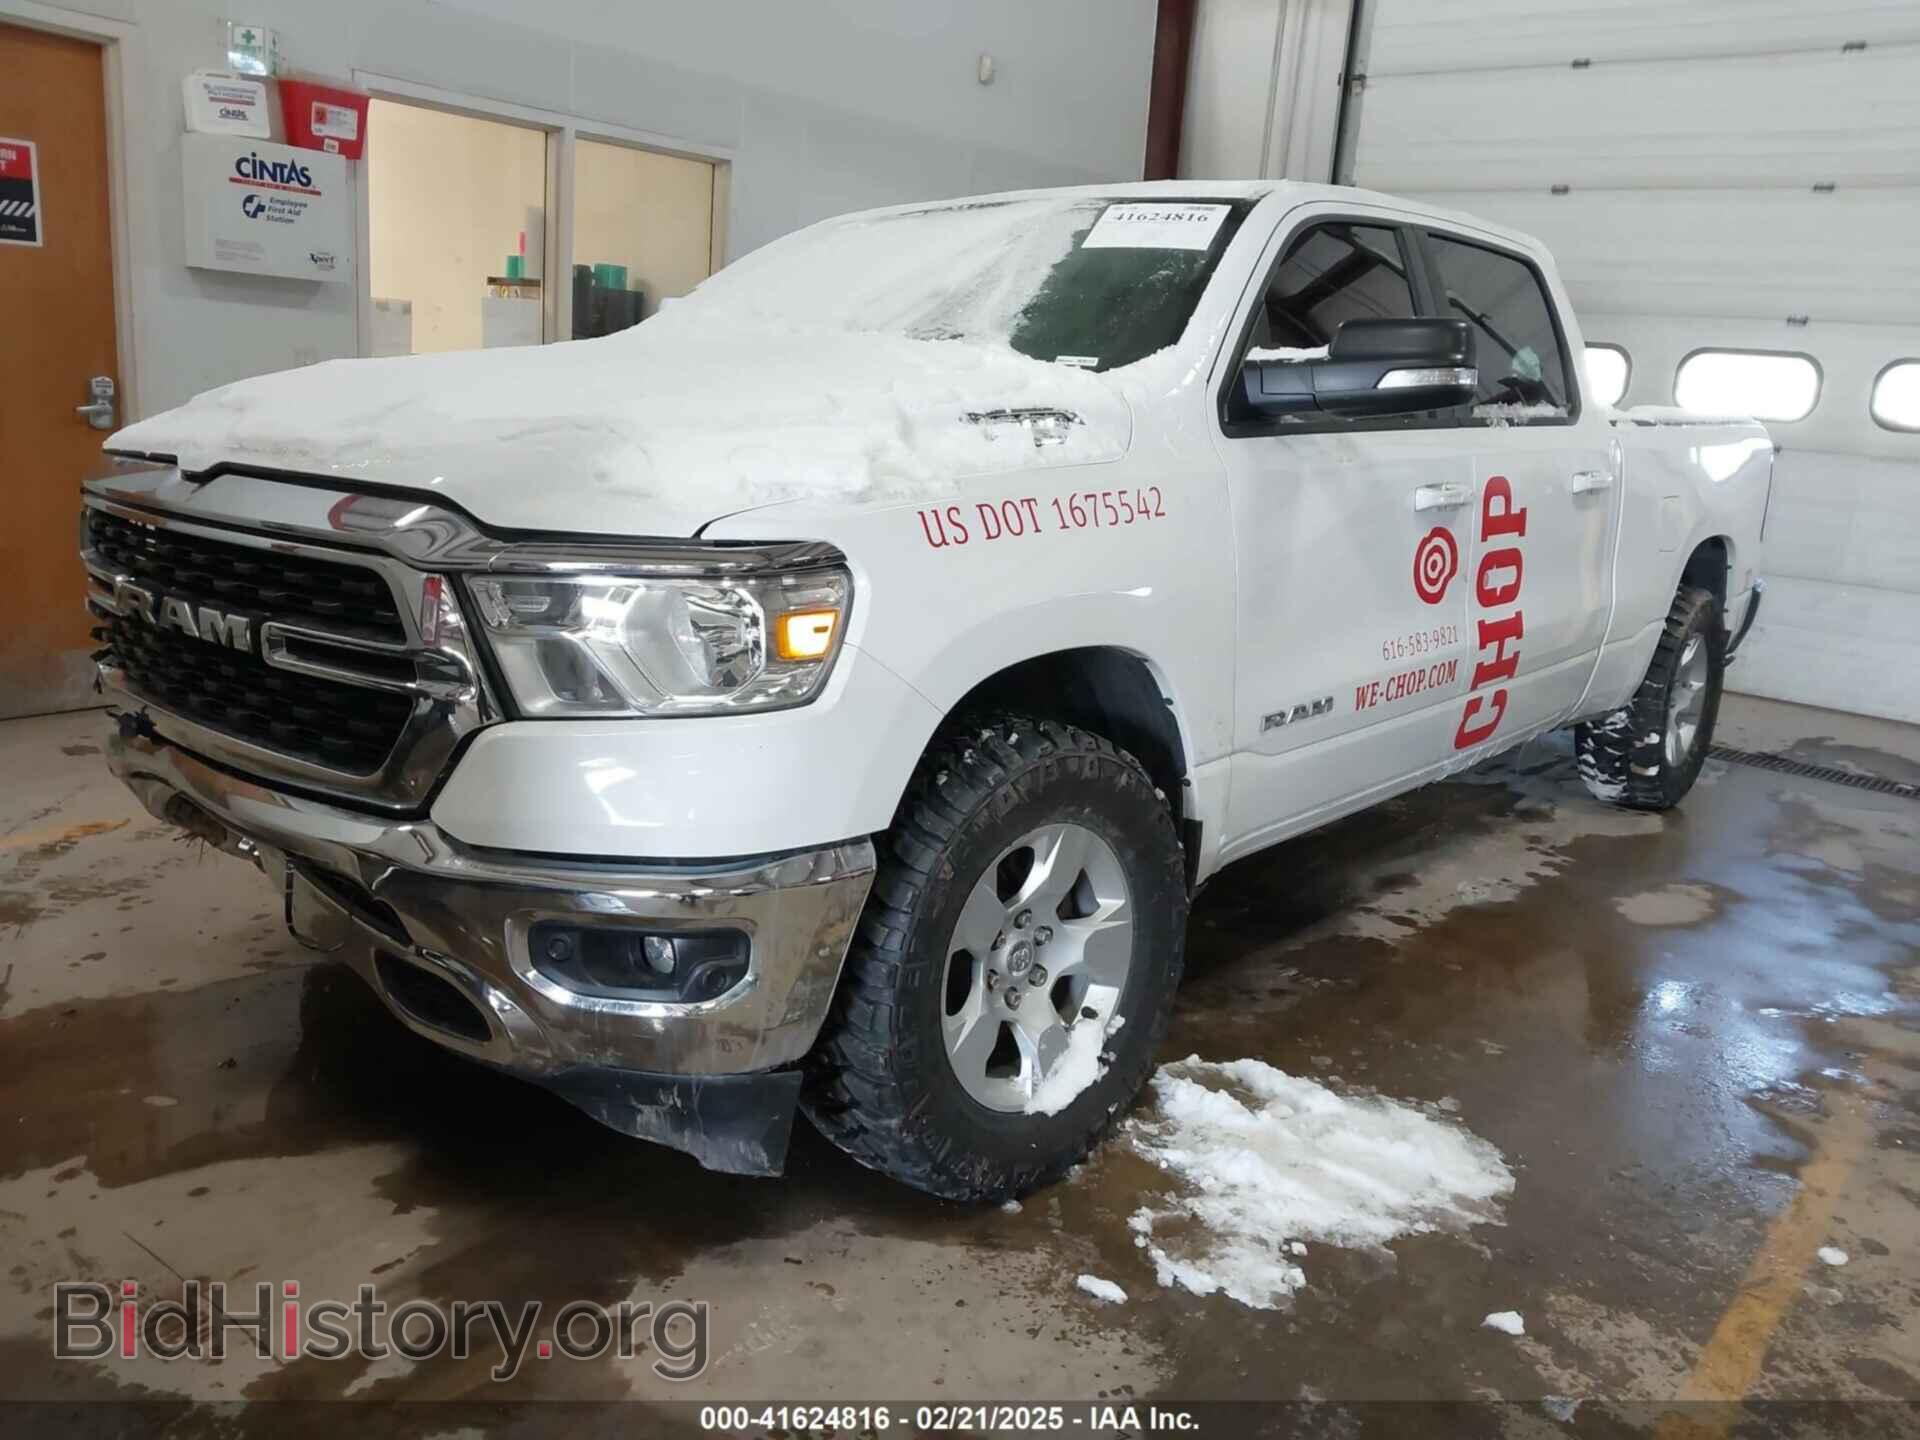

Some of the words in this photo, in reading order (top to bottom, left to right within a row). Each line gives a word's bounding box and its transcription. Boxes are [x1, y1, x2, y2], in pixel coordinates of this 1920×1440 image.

[267, 205, 285, 214] First
[287, 207, 302, 216] Aid
[1115, 212, 1209, 222] 41624816
[918, 506, 969, 548] US
[975, 497, 1042, 540] DOT
[1051, 486, 1166, 530] 1675542
[113, 583, 253, 651] RAM
[1454, 476, 1527, 750] CHOP
[1382, 625, 1459, 661] 616-583-9821
[1355, 659, 1459, 711] WE-CHOP.COM
[1260, 696, 1334, 732] RAM
